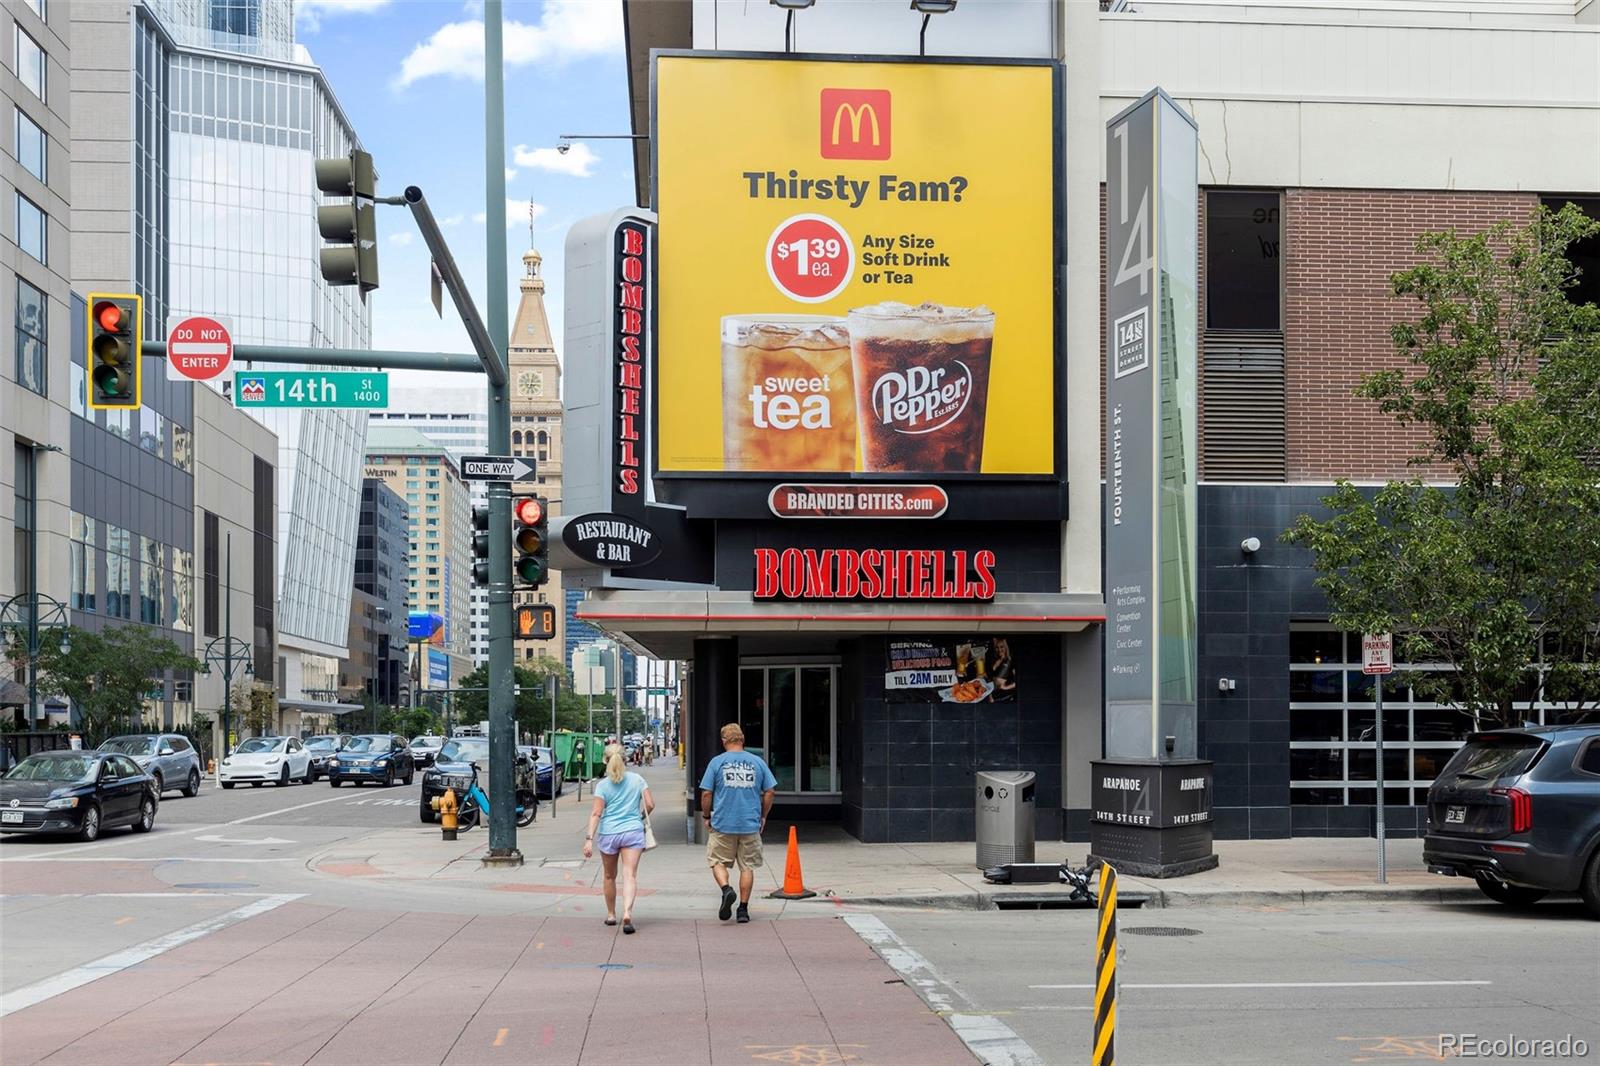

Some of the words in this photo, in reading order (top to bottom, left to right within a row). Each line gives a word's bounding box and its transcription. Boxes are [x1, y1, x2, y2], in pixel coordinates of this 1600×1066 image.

[743, 170, 870, 208] Thirsty
[879, 174, 968, 203] Fam?
[862, 234, 895, 252] Any
[899, 235, 935, 249] Size
[862, 252, 899, 267] Soft
[903, 252, 950, 268] Drink
[862, 273, 881, 284] or
[884, 271, 913, 284] Tea
[177, 329, 193, 340] DO
[201, 329, 223, 340] NOT
[182, 357, 218, 368] ENTER
[620, 228, 643, 495] BOMBSHELLS
[361, 379, 372, 390] St
[764, 374, 831, 393] sweet
[906, 366, 946, 398] Dr
[274, 378, 337, 403] 14th
[353, 391, 380, 402] 1400
[749, 385, 832, 429] tea
[876, 372, 966, 426] Pepper
[365, 467, 397, 477] WESTIN
[468, 463, 489, 474] ONE
[492, 463, 514, 475] WAY
[787, 492, 854, 510] BRANDED
[857, 492, 933, 510] CITIES.com
[576, 520, 651, 548] RESTAURANT
[597, 542, 606, 560] &
[608, 543, 631, 562] BAR
[754, 548, 996, 599] BOMBSHELLS
[1364, 641, 1390, 650] PARKING
[895, 676, 908, 685] TILL
[909, 673, 932, 685] 2AM
[933, 675, 953, 684] DAILY
[1103, 777, 1141, 791] ARAPAHOE
[1096, 811, 1114, 821] 14TH
[1117, 813, 1151, 825] STREET
[1173, 814, 1189, 824] 14TH
[1191, 811, 1208, 822] STREET
